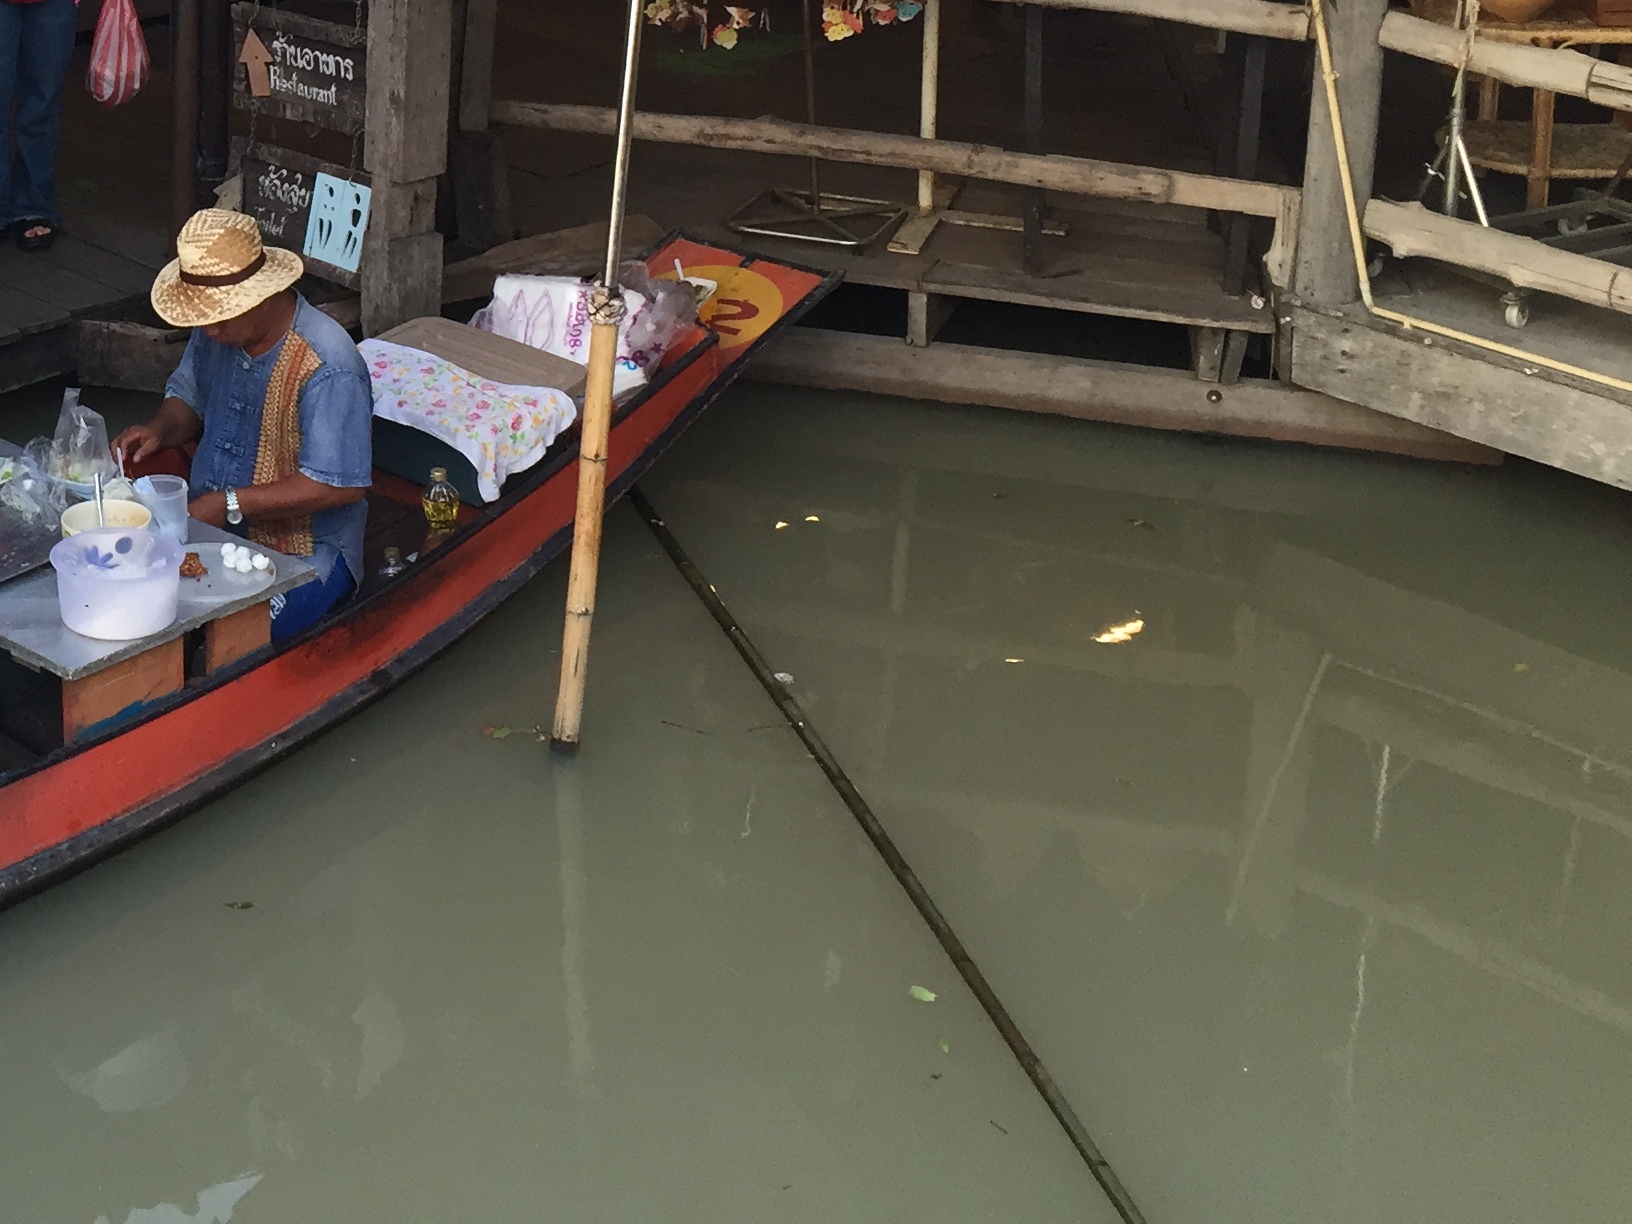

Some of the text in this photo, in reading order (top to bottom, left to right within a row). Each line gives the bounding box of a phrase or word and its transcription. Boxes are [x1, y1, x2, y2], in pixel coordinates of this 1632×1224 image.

[271, 30, 354, 82] ร้านอาหาร
[269, 64, 338, 106] Restaurant
